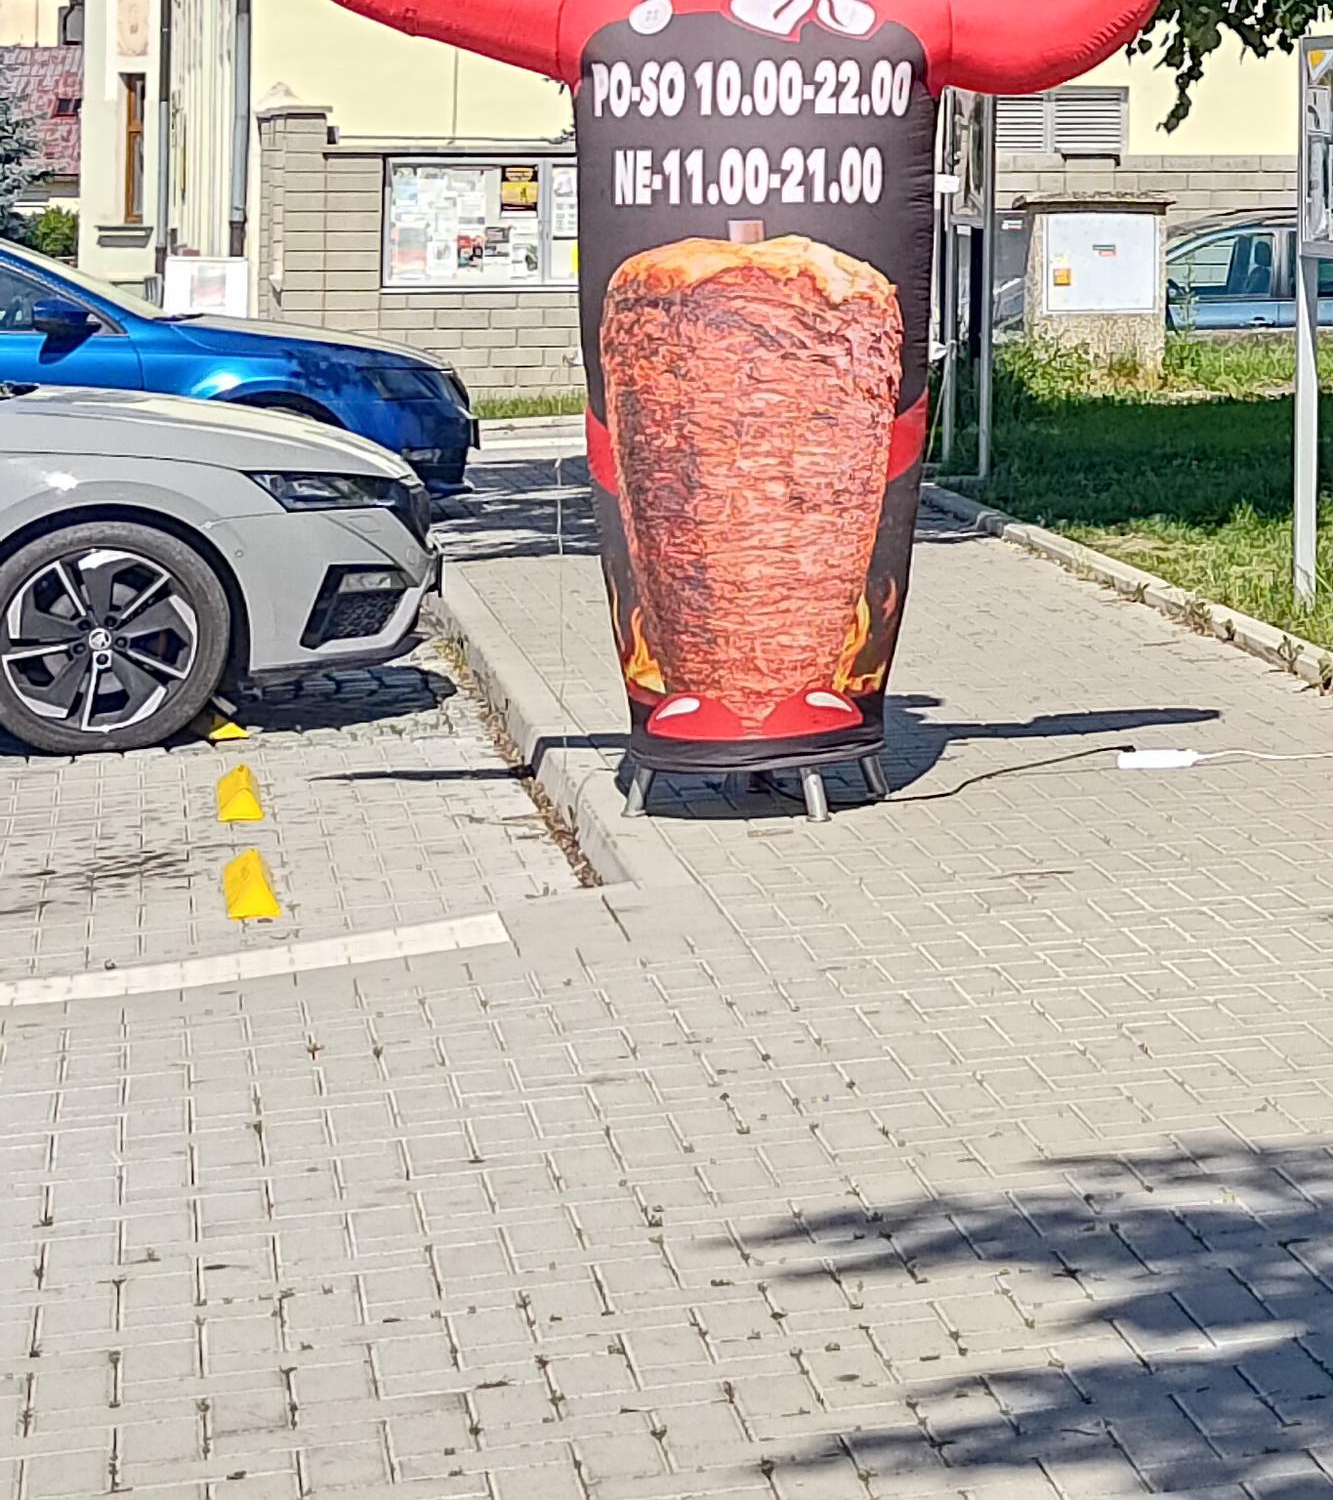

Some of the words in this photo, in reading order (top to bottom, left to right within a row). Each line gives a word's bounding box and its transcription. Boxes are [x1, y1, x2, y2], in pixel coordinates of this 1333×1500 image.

[591, 60, 686, 118] PO-SO
[694, 59, 913, 116] 10.00-22.00
[614, 147, 883, 205] NE-11.00-21.00
